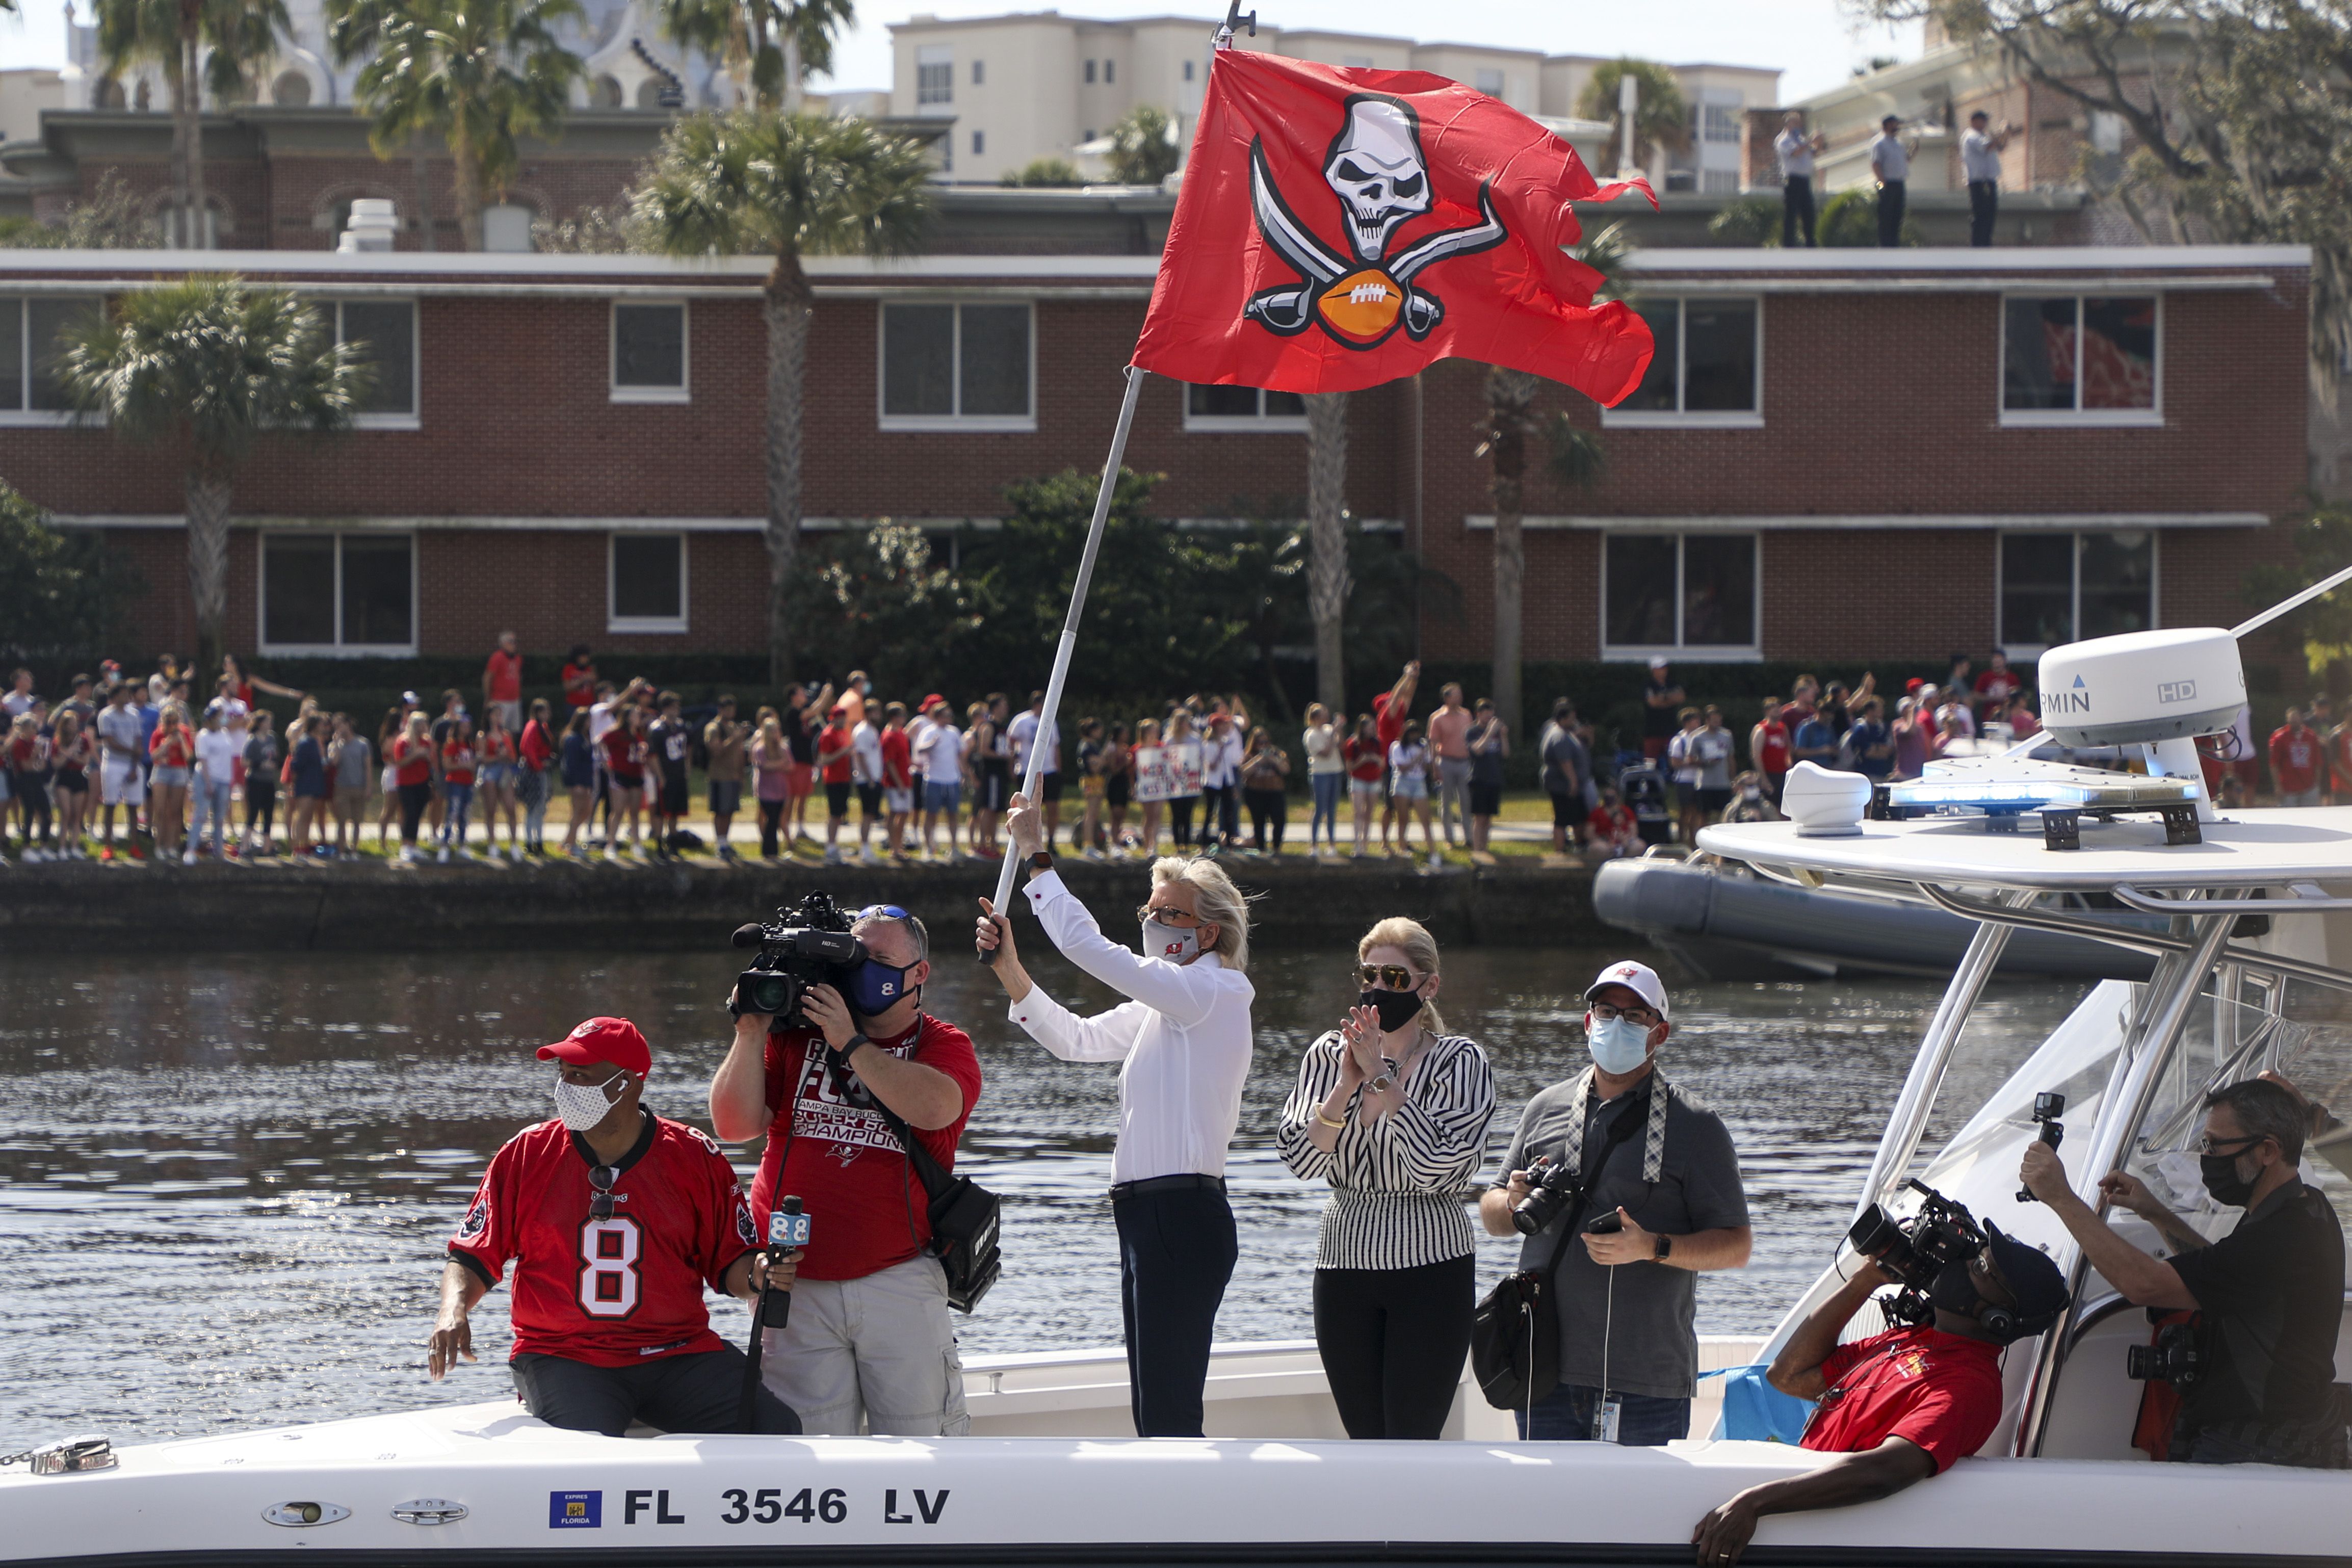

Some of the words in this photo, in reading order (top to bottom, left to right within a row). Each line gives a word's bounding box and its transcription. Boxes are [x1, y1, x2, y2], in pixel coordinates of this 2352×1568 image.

[2160, 682, 2194, 702] HD
[881, 982, 893, 996] 8
[793, 1111, 857, 1128] SUPER
[798, 1101, 829, 1113] AMPA
[832, 1107, 853, 1116] BAY
[687, 1126, 720, 1155] 8
[770, 1217, 789, 1240] 8
[794, 1219, 807, 1241] 8
[578, 1214, 642, 1318] 8
[624, 1489, 685, 1524] FL
[720, 1488, 847, 1524] 3546
[884, 1489, 951, 1524] LV
